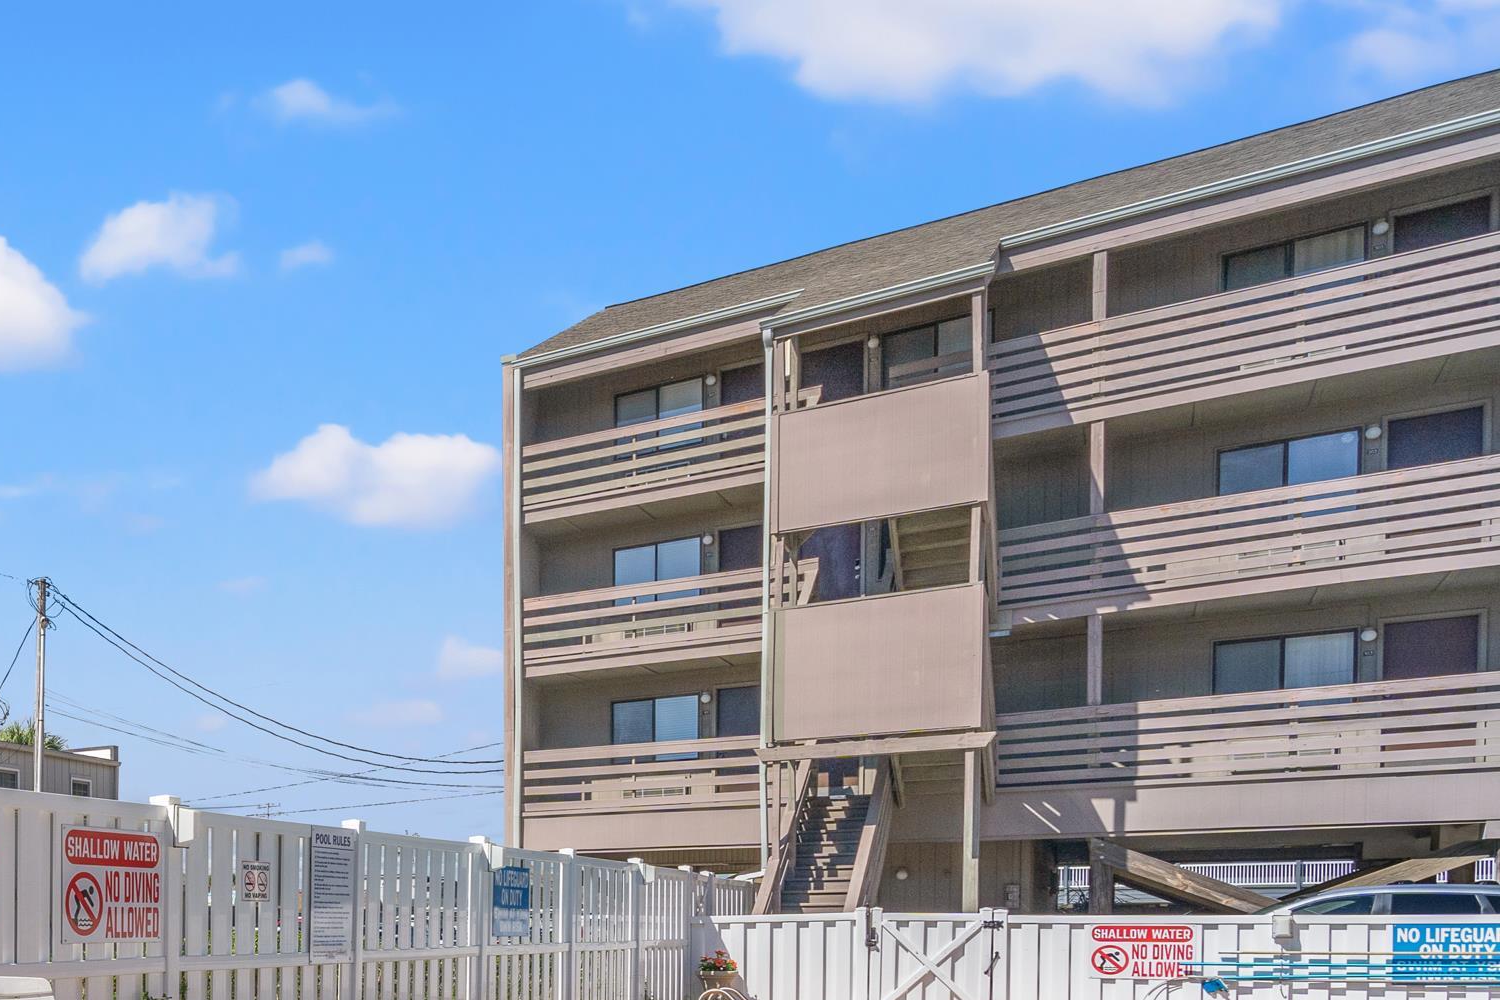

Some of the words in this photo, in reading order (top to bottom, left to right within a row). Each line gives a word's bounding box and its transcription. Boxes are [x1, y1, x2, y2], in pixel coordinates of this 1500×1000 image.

[315, 833, 332, 846] POOL
[332, 834, 351, 847] RULES
[67, 836, 120, 859] SHALLOW
[123, 840, 158, 862] WATER
[105, 870, 120, 902] NO
[124, 871, 160, 904] DIVING
[501, 888, 509, 905] ON
[509, 889, 523, 907] DUTY
[105, 906, 159, 939] ALLOWED
[1093, 928, 1148, 939] SHALLOW
[1151, 929, 1191, 939] WATER
[1396, 927, 1420, 943] NO
[1131, 944, 1148, 960] NO
[1152, 944, 1193, 960] DIVING
[1419, 943, 1443, 959] ON
[1448, 943, 1497, 959] DUTY
[1131, 961, 1193, 977] ALLOWED
